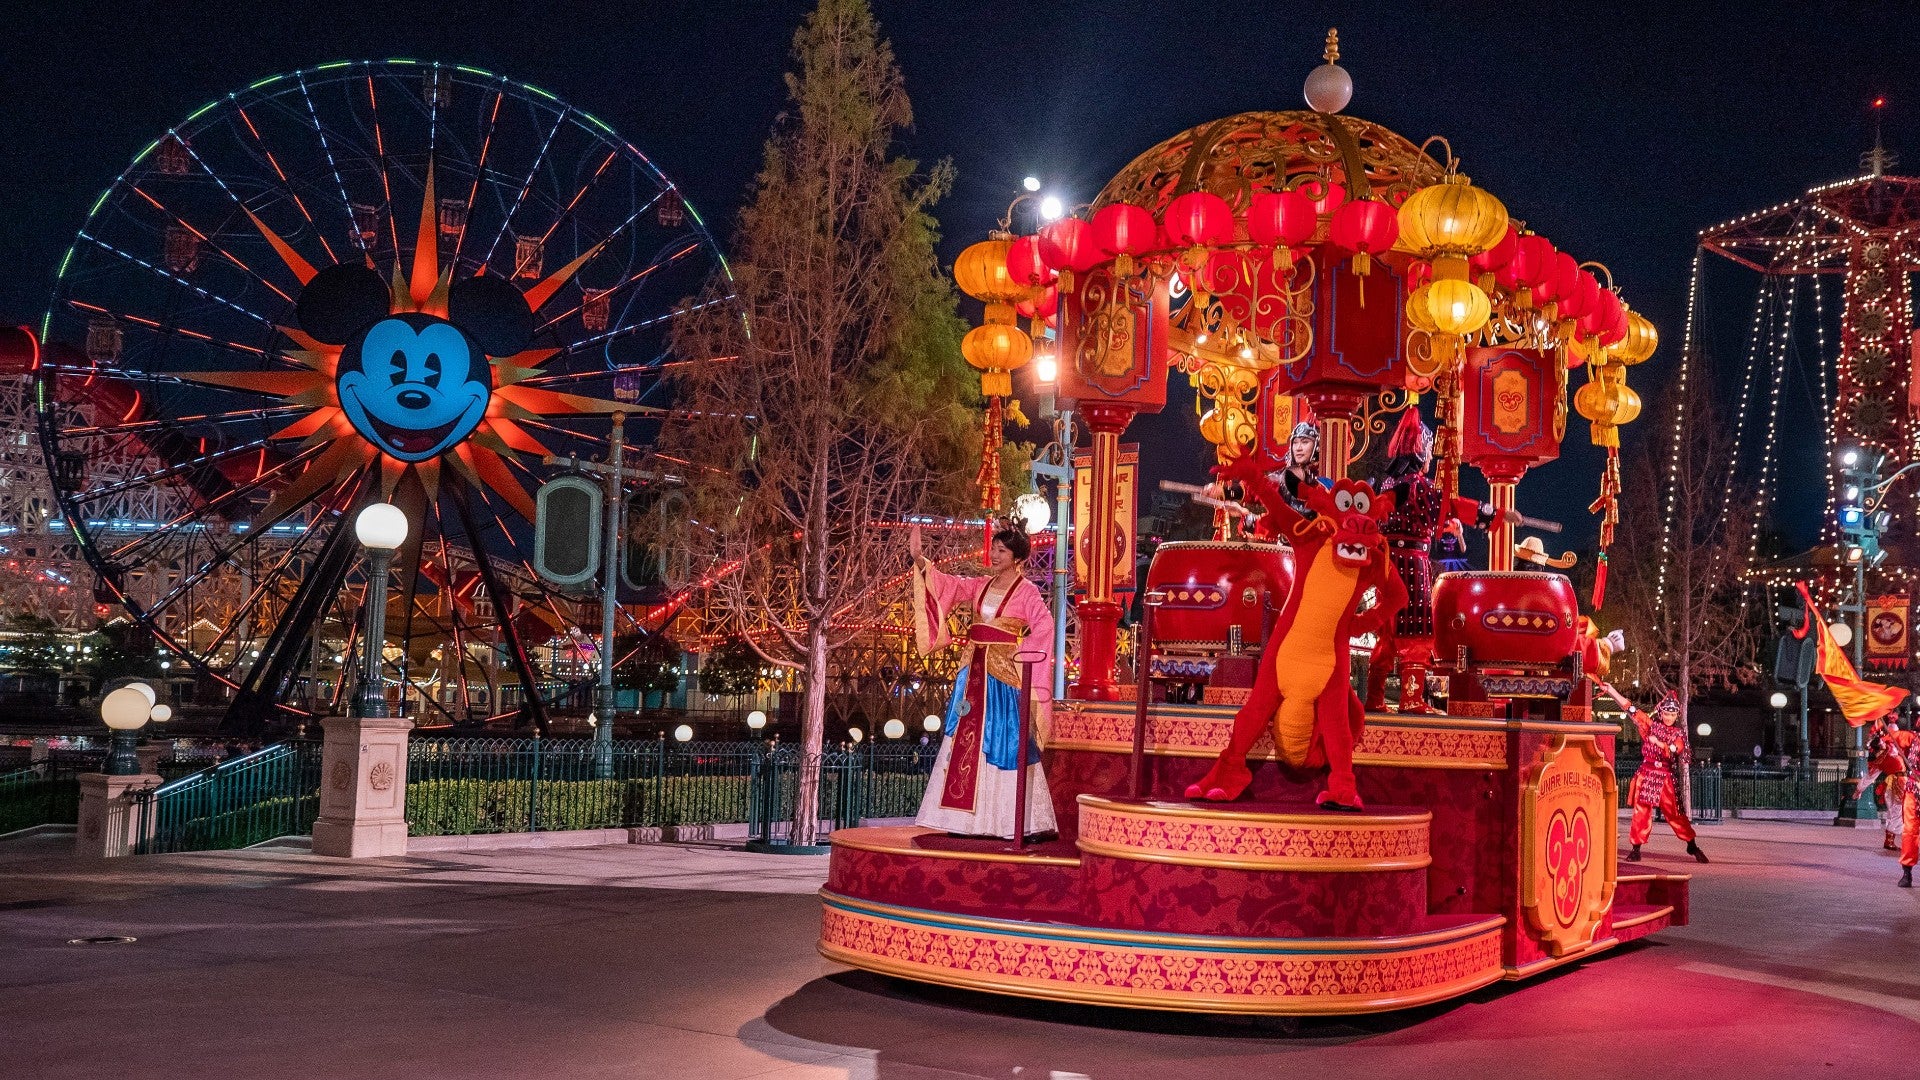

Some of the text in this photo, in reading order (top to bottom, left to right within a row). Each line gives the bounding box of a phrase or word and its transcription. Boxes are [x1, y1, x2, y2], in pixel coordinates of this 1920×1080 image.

[1538, 774, 1561, 797] UNAR
[1563, 772, 1580, 786] NEW
[1583, 775, 1602, 795] YEAR
